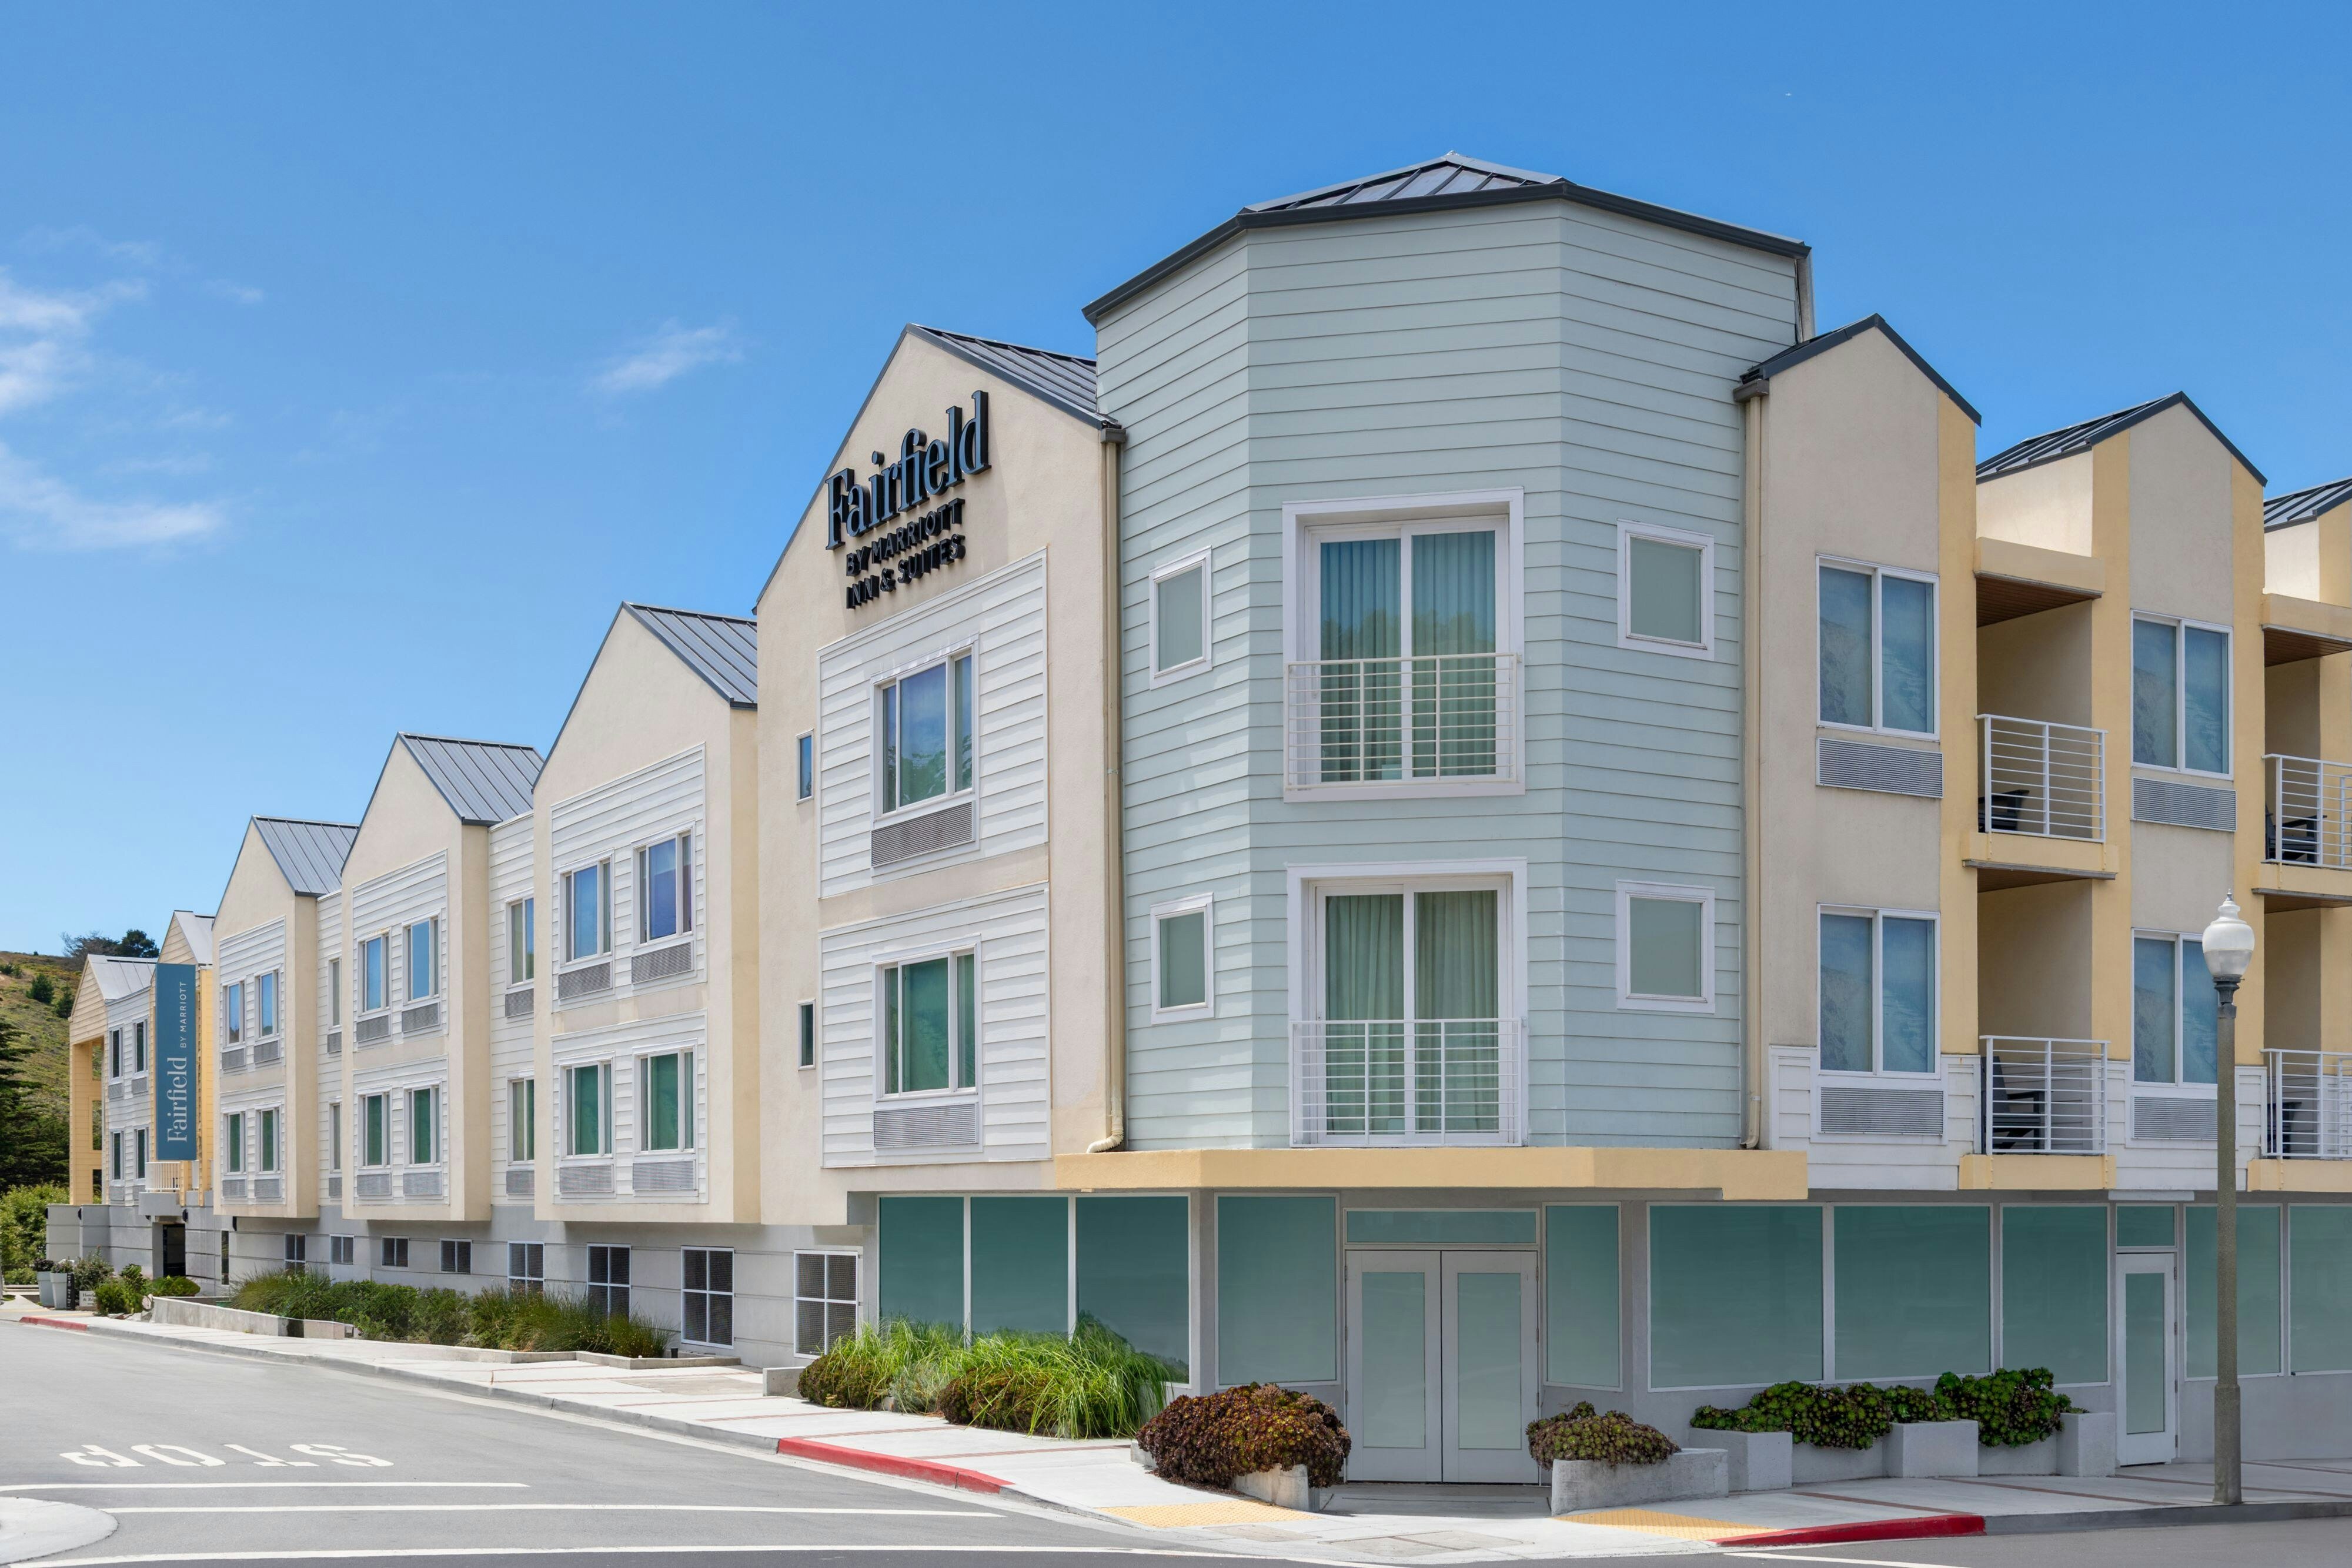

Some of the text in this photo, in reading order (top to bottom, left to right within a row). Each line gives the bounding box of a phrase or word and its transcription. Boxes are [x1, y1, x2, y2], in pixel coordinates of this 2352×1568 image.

[825, 390, 992, 550] Fairfield
[846, 498, 965, 576] BY MARRIOTT
[846, 534, 965, 609] INN & SUITES
[166, 1057, 187, 1142] Fairfield
[180, 1037, 187, 1048] BY
[59, 1444, 395, 1467] STOP
